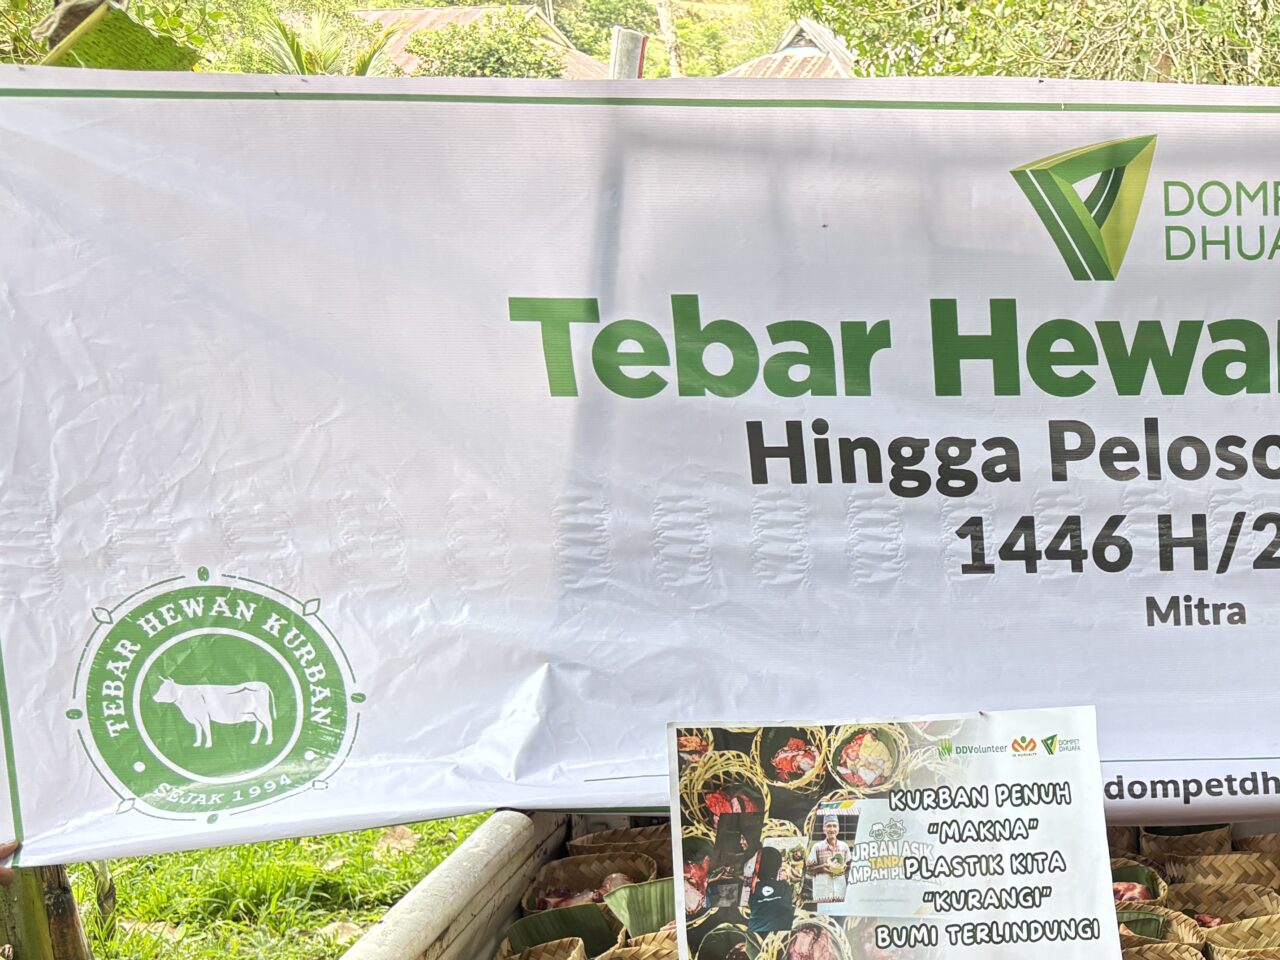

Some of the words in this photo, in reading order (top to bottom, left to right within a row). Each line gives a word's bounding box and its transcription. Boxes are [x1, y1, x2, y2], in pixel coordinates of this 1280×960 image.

[508, 293, 892, 399] Tebar
[746, 418, 1022, 498] Hingga
[955, 514, 1133, 574] 1446
[1145, 594, 1247, 627] Mitra
[102, 639, 142, 737] TEBAR
[136, 596, 257, 637] HEWAN
[261, 612, 331, 725] KURBAN
[955, 744, 1008, 755] DDVolunteer
[152, 782, 224, 805] SEJAK
[232, 773, 293, 801] 1994
[889, 785, 989, 812] KURBAN
[995, 781, 1072, 807] PENUH
[904, 854, 1004, 881] PLASTIK
[1010, 850, 1066, 875] KITA
[875, 923, 938, 949] BUMI
[946, 918, 1100, 946] TERLINDUNGI
